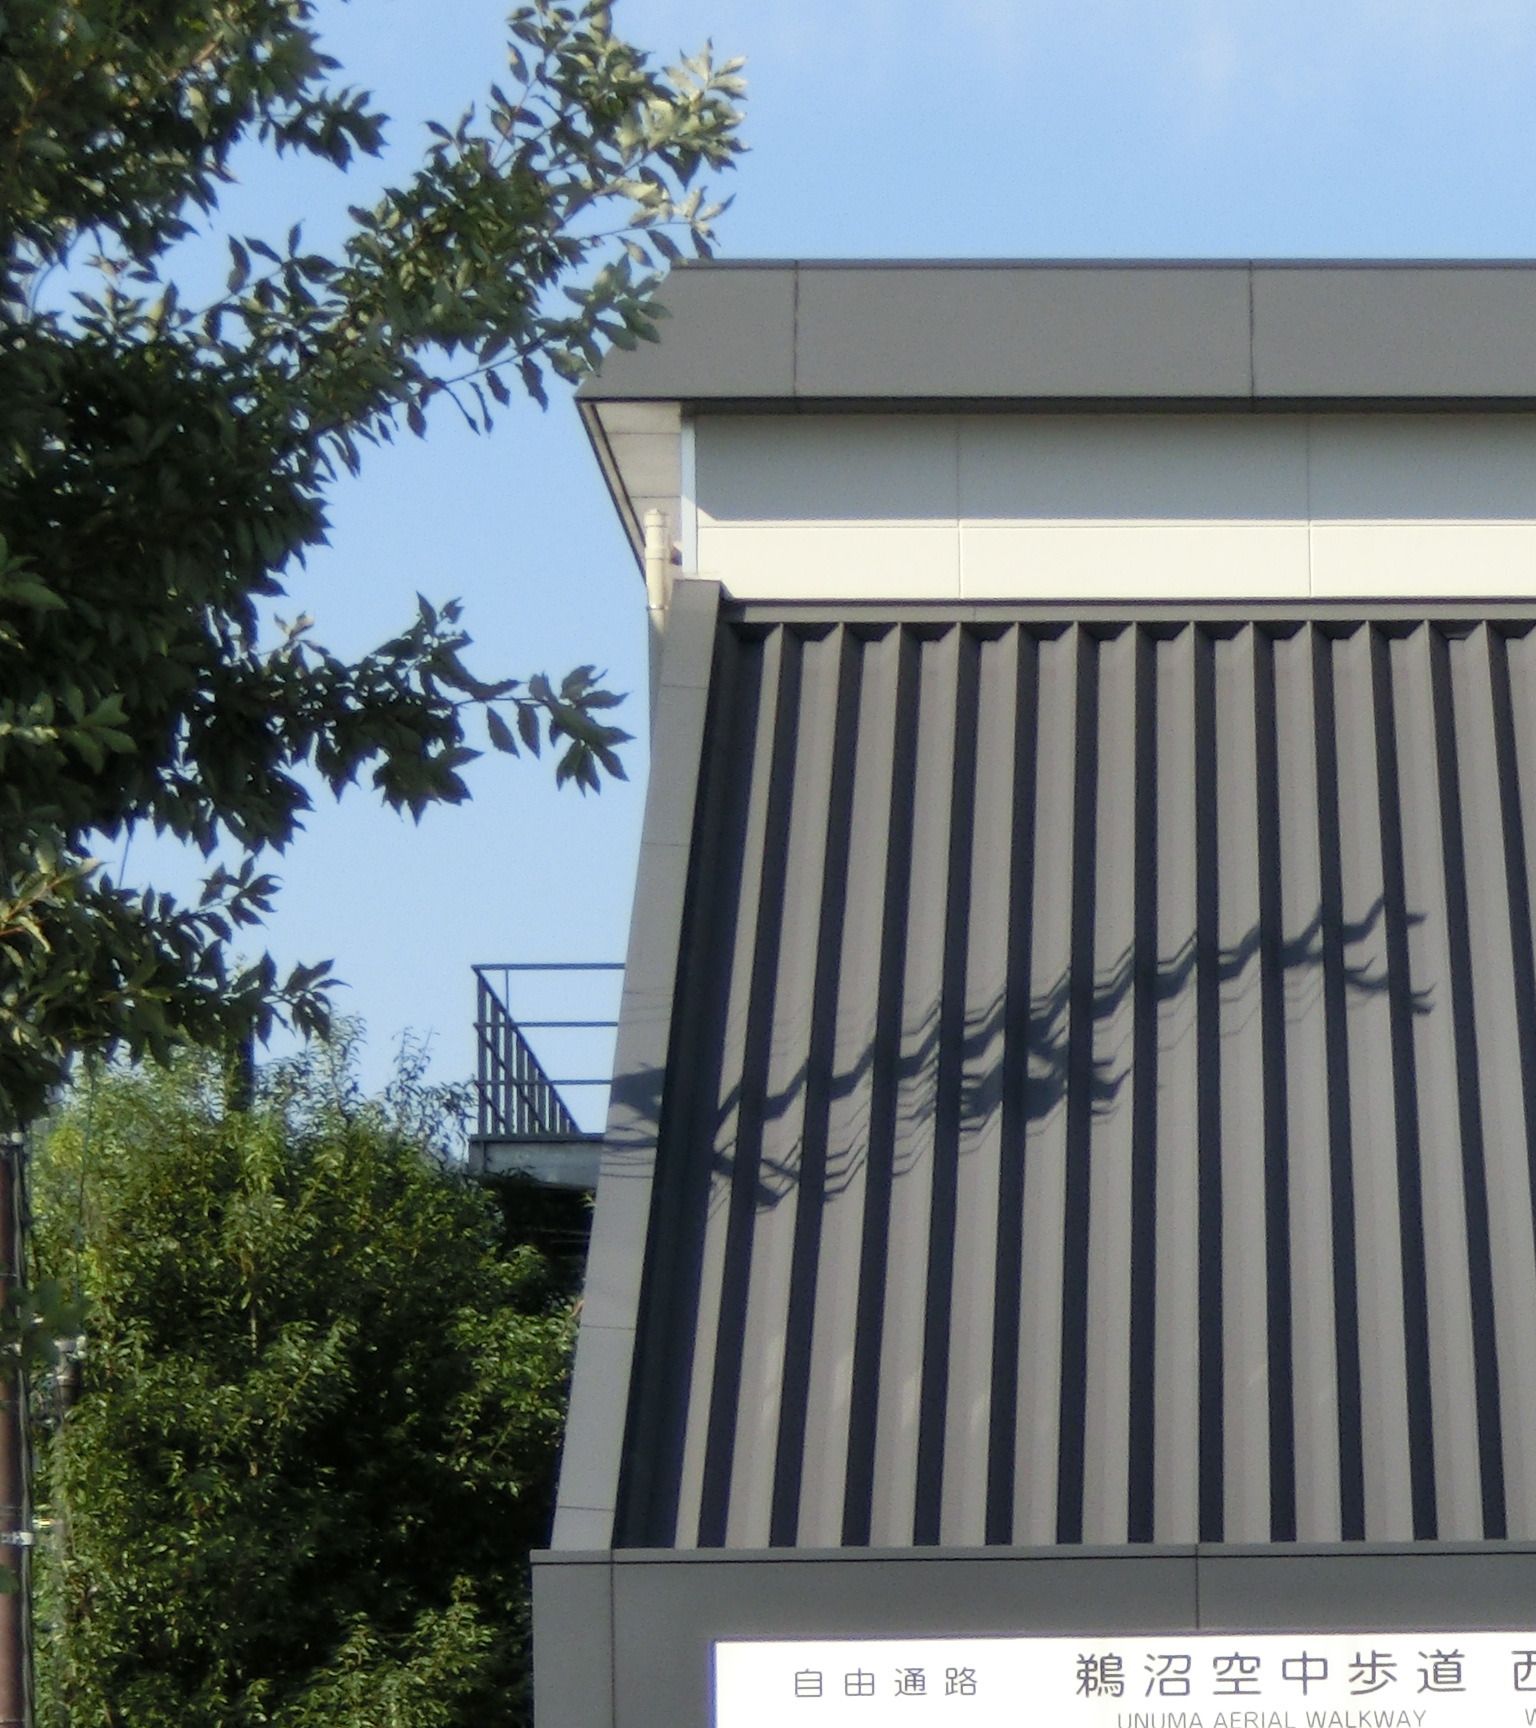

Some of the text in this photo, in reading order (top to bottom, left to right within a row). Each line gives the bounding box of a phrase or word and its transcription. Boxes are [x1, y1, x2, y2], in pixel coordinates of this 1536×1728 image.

[795, 1667, 976, 1697] 自由通路
[1306, 1710, 1426, 1728] WALKWAY
